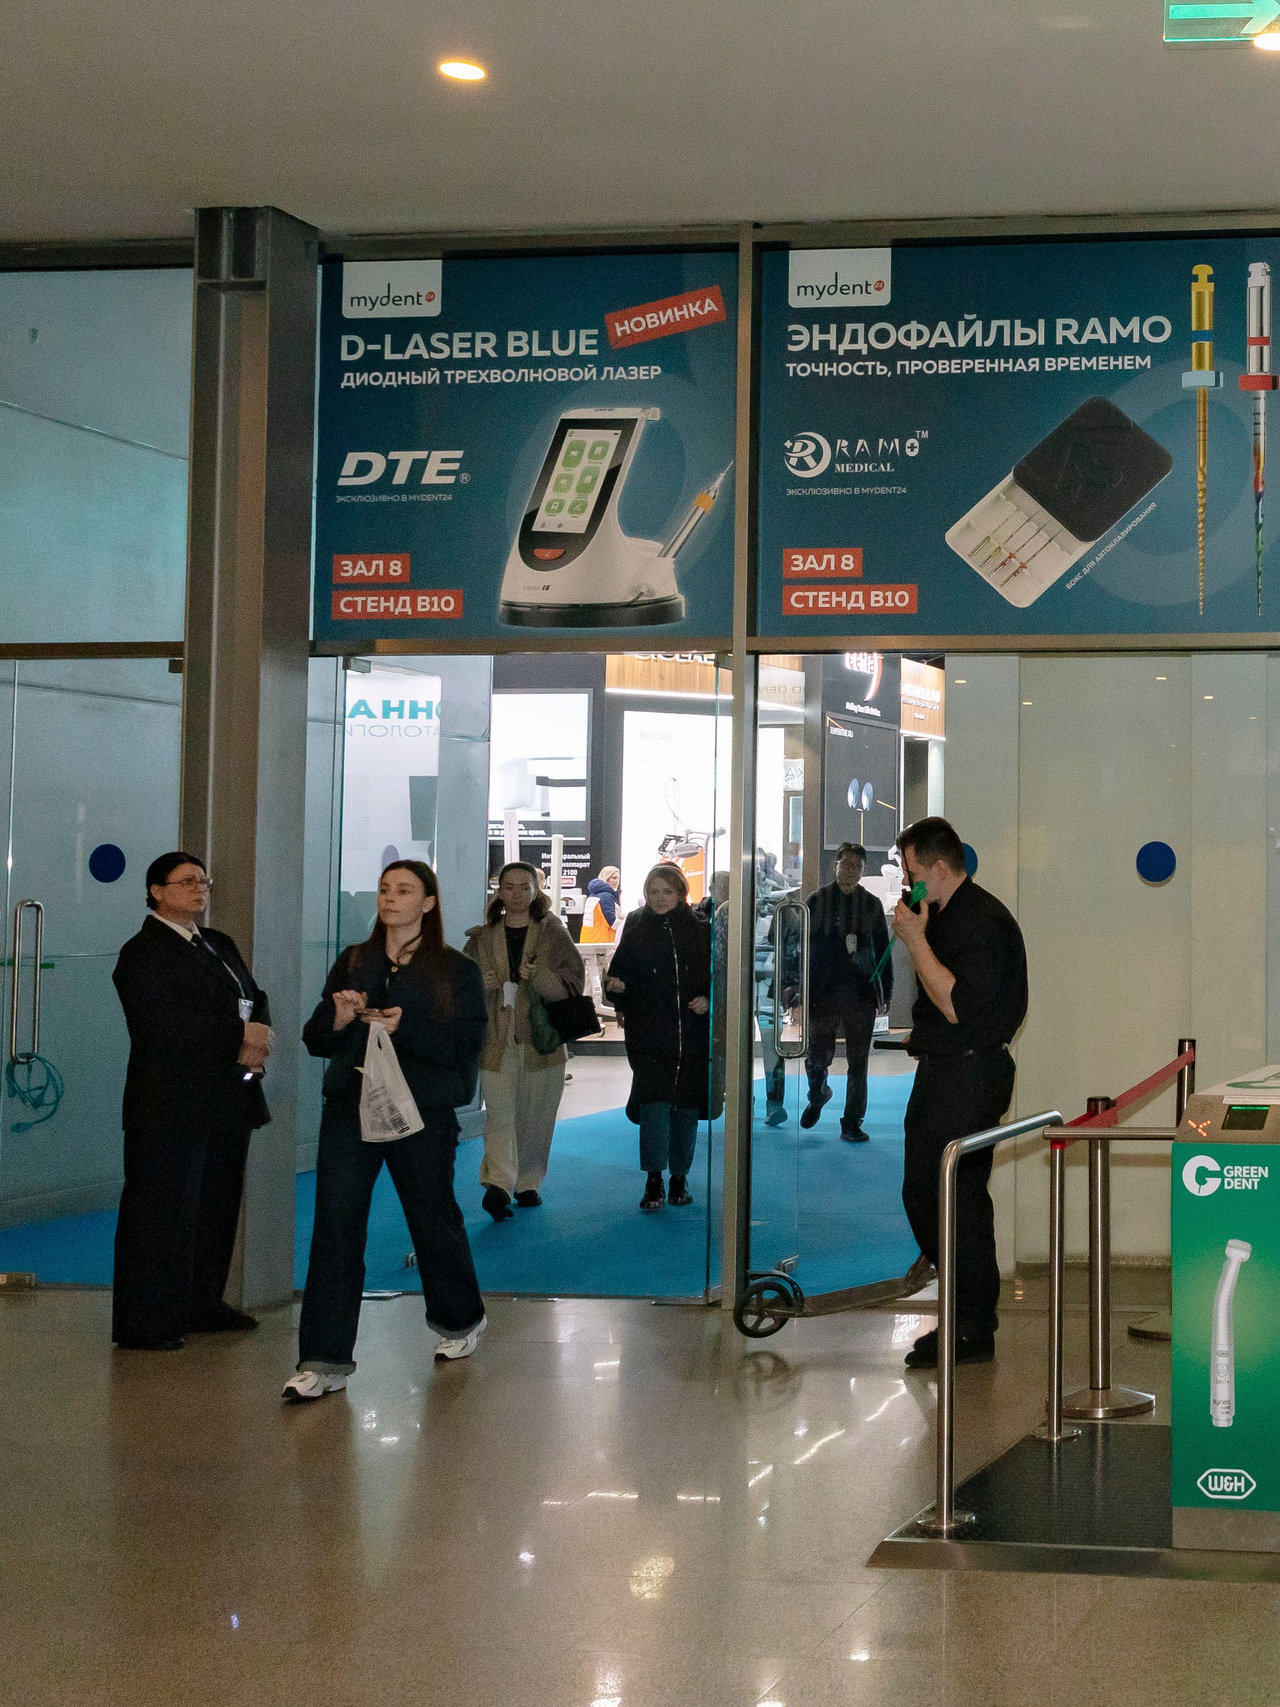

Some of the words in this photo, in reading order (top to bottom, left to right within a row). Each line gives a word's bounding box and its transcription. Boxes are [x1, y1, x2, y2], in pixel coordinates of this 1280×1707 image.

[614, 298, 719, 337] НОВИНКА
[787, 313, 1046, 354] ЭНДОФАЙЛЫ
[1056, 315, 1172, 346] RAMO
[341, 333, 498, 362] D-LASER
[507, 329, 599, 357] BLUE
[786, 360, 892, 378] ТОЧНОСТЬ,
[896, 356, 1040, 375] ПРОВЕРЕННАЯ
[1045, 355, 1152, 372] ВРЕМЕНЕМ
[341, 368, 440, 389] ДИОДНЫЙ
[444, 365, 597, 385] ТРЕХВОЛНОВОЙ
[600, 366, 662, 381] ЛАЗЕР
[834, 463, 895, 473] MEDICAL
[336, 494, 400, 503] ЭКСКЛЮЗИВНО
[408, 493, 453, 502] MYDENT24
[786, 488, 853, 496] ЭКСКЛЮЗИВНО
[861, 486, 907, 495] MYDENT24
[1065, 572, 1084, 590] БОКС
[1082, 560, 1097, 576] ДЛЯ
[1095, 502, 1157, 562] АВТОКЛАВИРОВАНИЯ
[340, 560, 385, 577] ЗАЛ
[388, 559, 402, 576] 8
[790, 554, 836, 572] ЗАЛ
[841, 554, 855, 571] 8
[339, 596, 413, 615] СТЕНД
[790, 591, 865, 611] СТЕНД
[1223, 1165, 1269, 1178] GREEN
[1224, 1178, 1261, 1190] DENT
[1207, 1475, 1246, 1493] W&H
